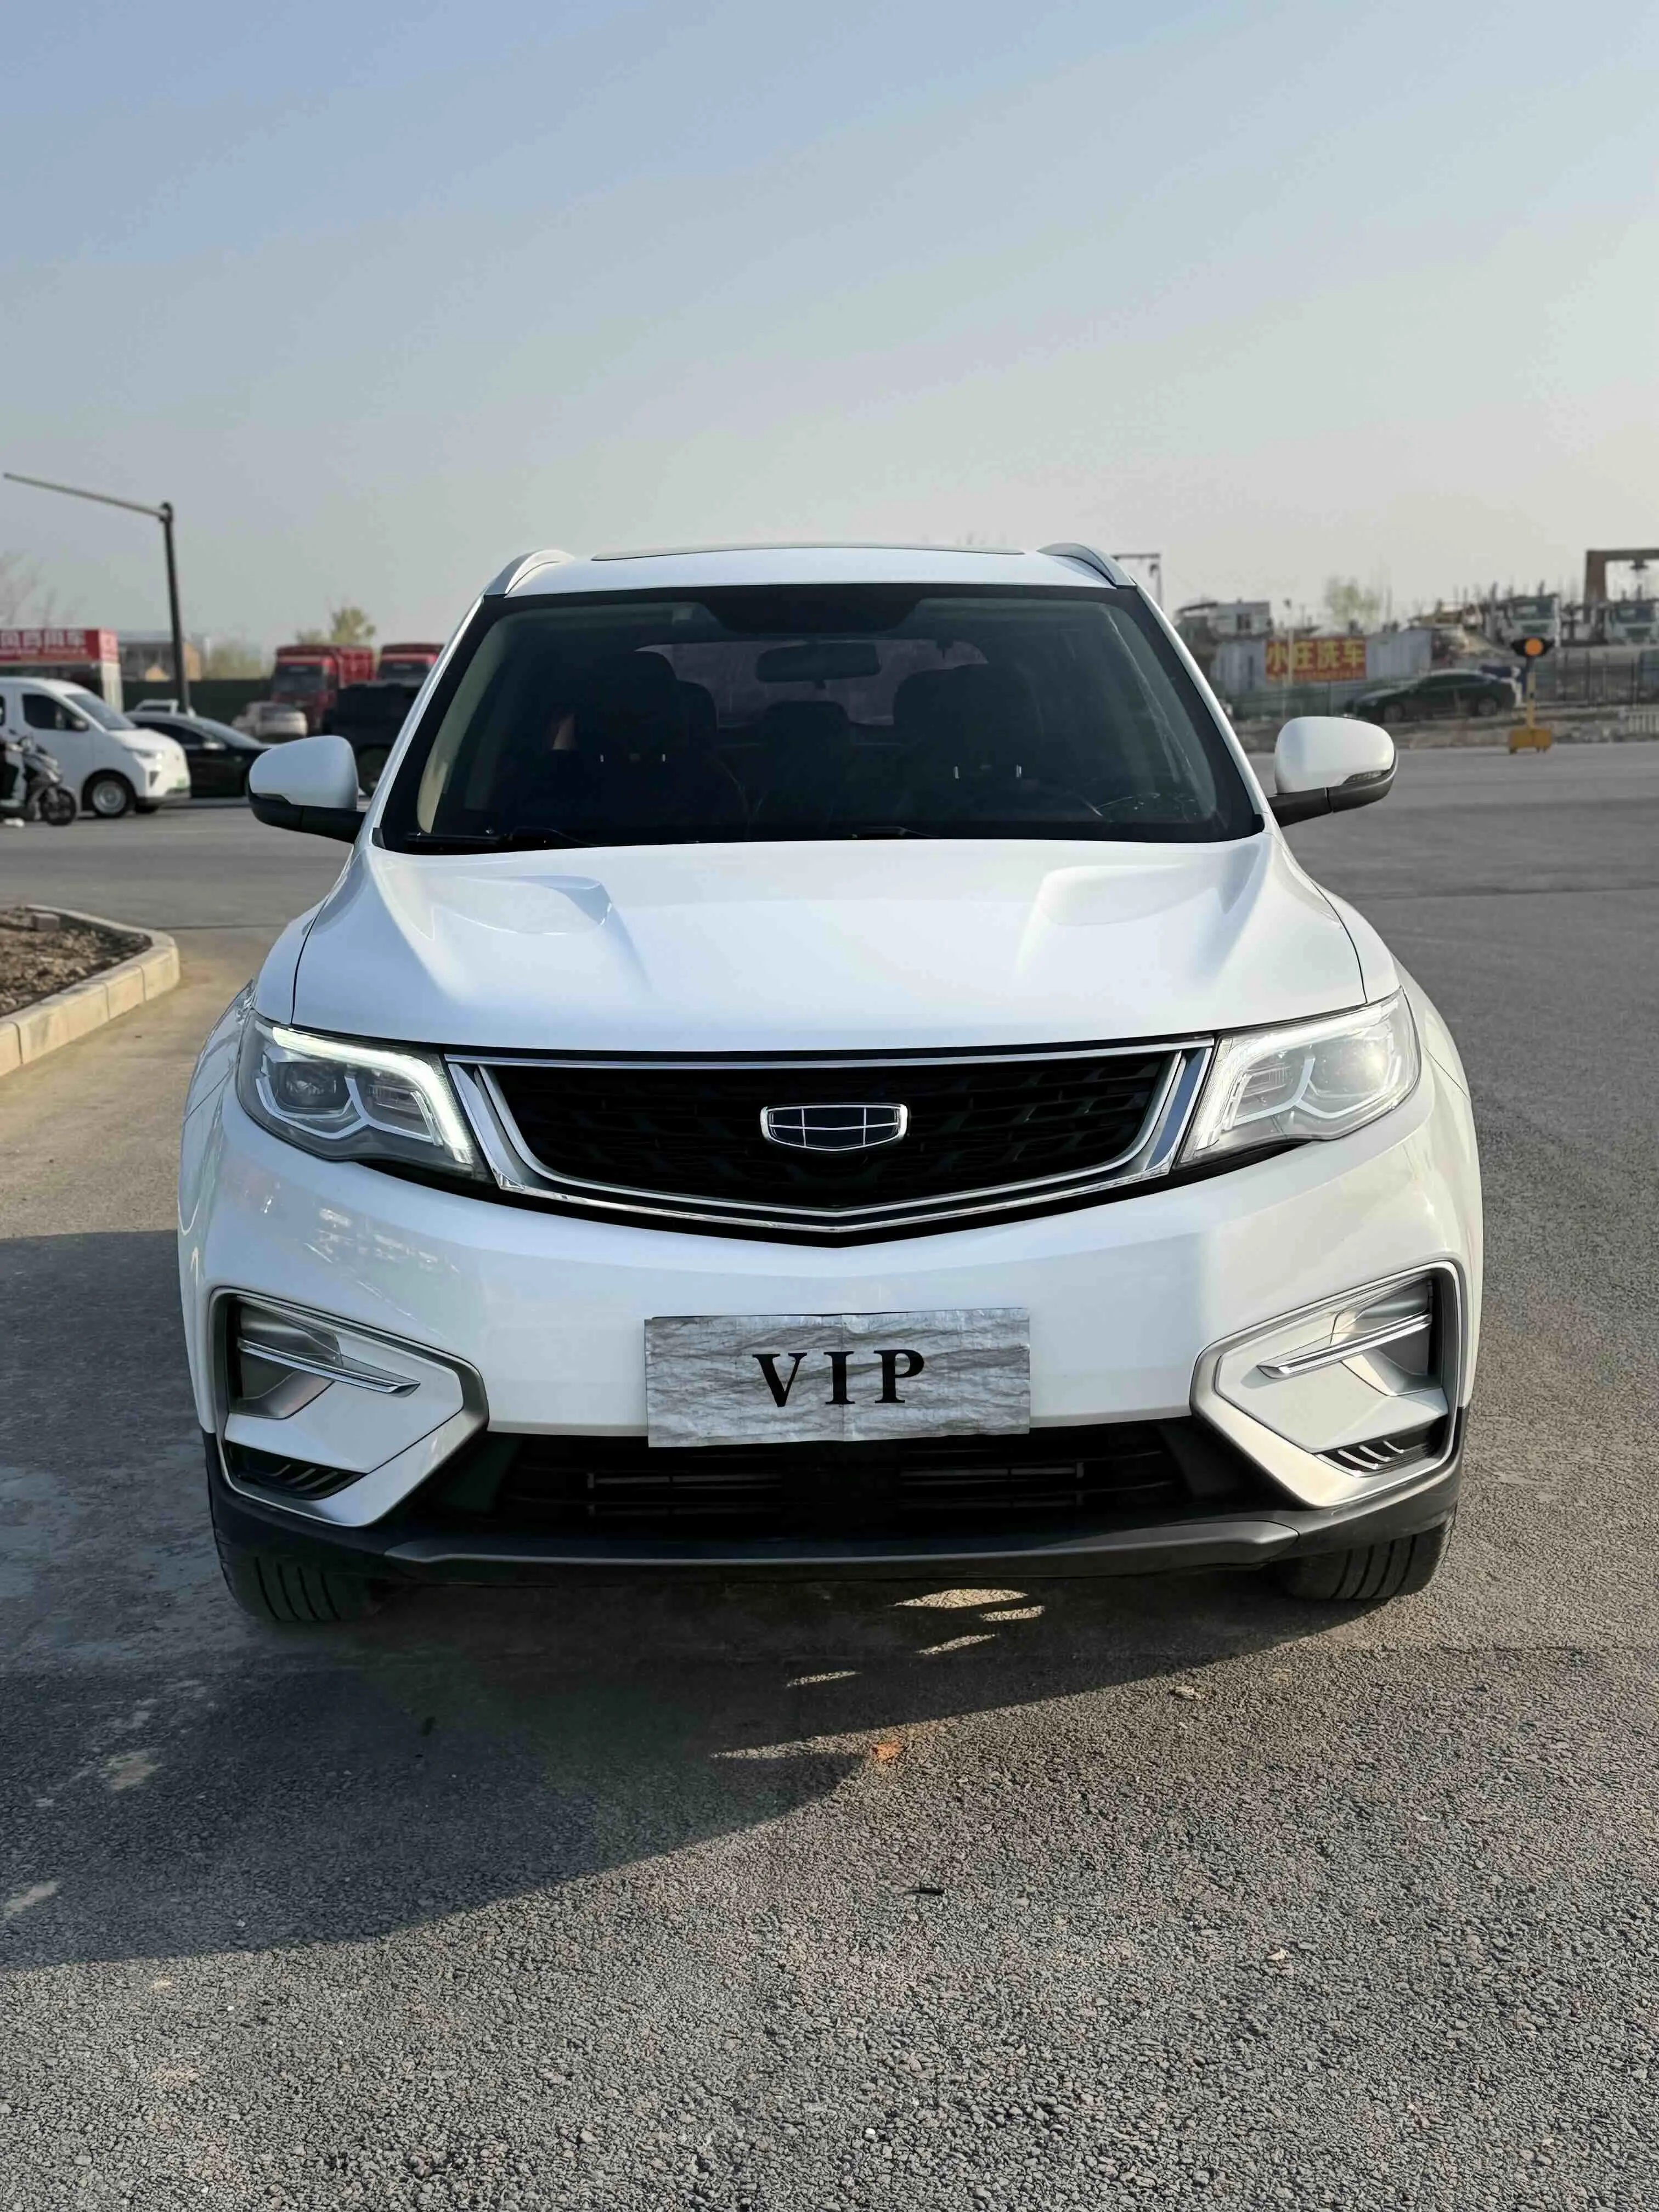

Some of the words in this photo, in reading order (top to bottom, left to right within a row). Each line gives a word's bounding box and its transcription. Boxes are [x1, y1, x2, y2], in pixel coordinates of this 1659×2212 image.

[1267, 639, 1365, 672] 小庄洗车
[753, 1349, 925, 1408] VIP
